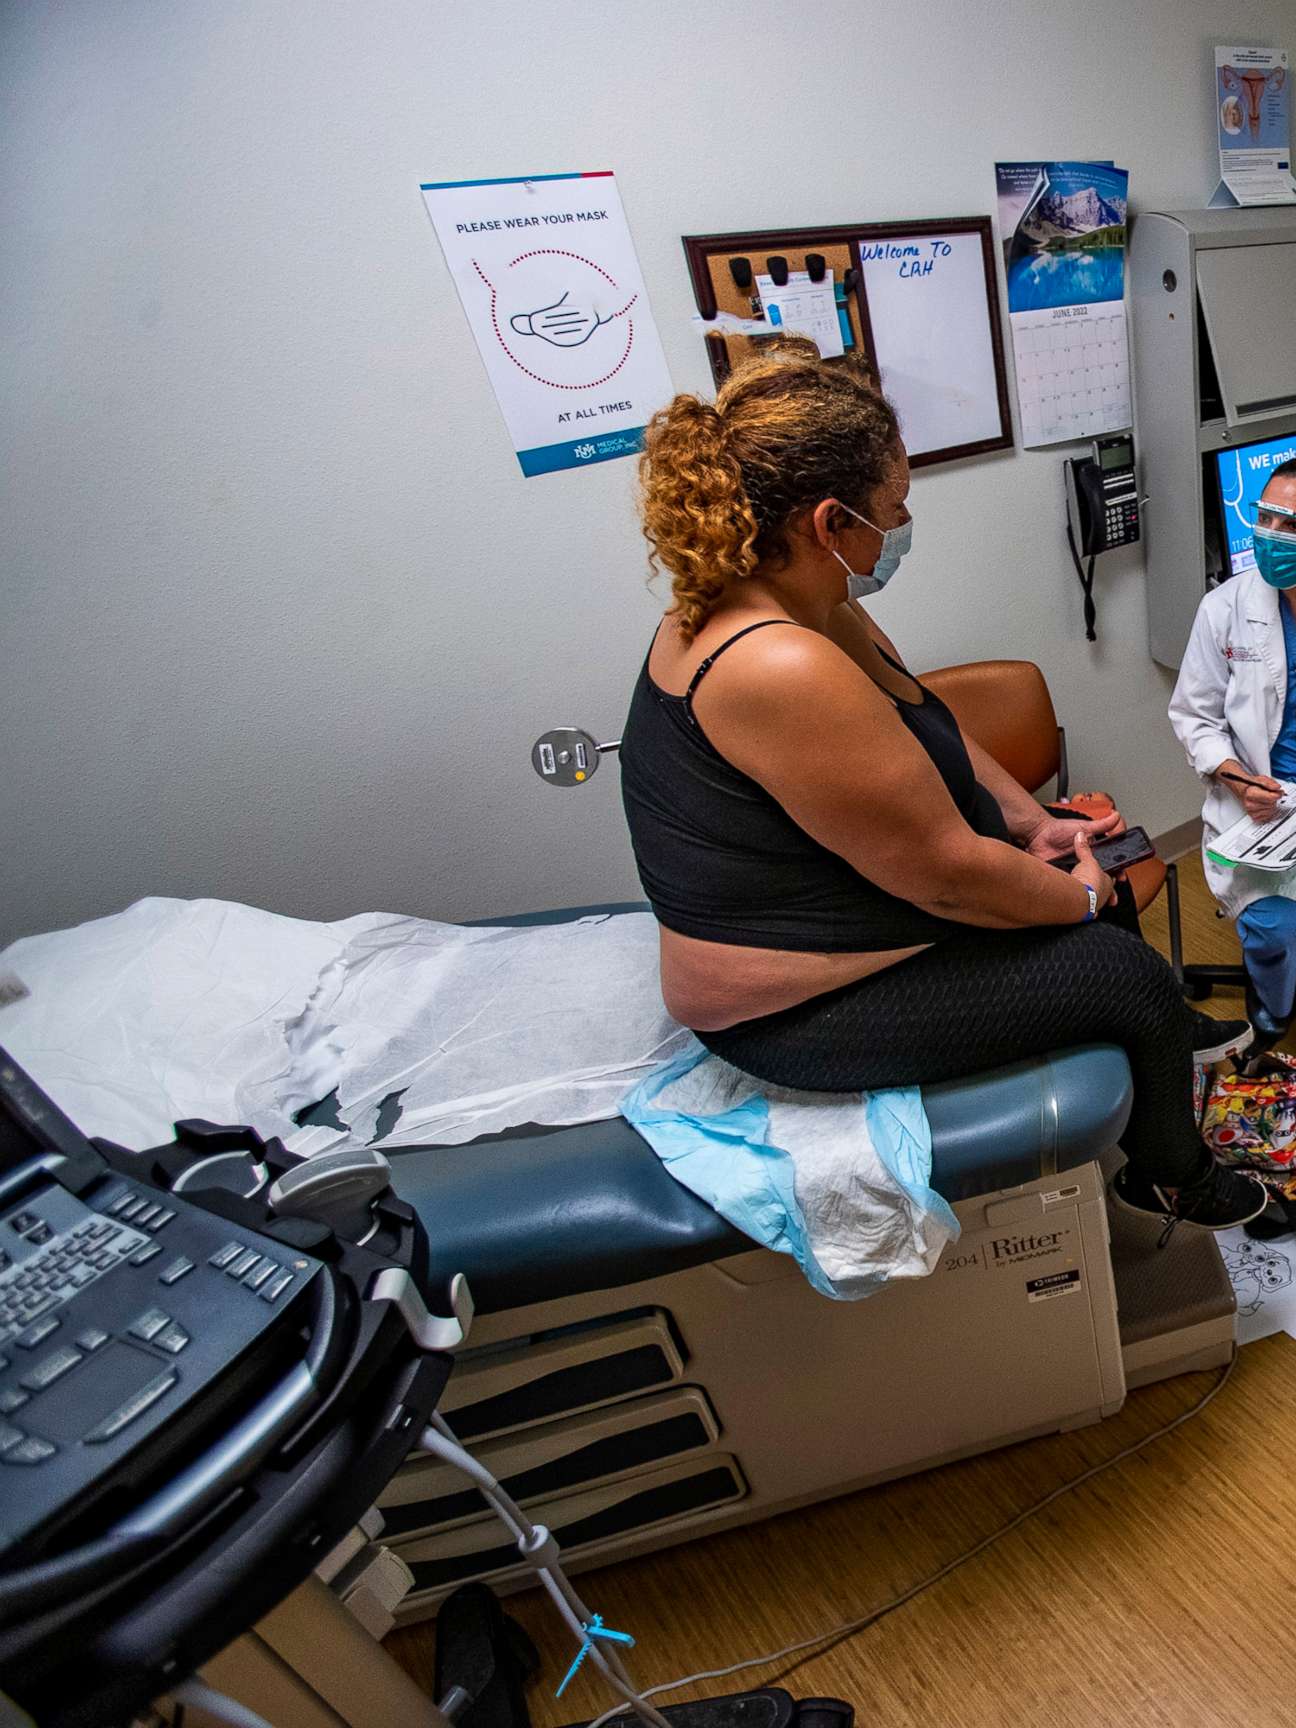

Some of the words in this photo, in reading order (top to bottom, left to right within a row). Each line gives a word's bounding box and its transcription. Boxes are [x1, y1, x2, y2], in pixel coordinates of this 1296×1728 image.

[456, 220, 501, 234] PLEASE
[504, 217, 540, 229] WEAR
[542, 213, 574, 225] YOUR
[576, 210, 609, 222] MASK
[862, 244, 920, 260] Welcome
[1052, 308, 1072, 319] JUNE
[1072, 306, 1088, 316] 2022
[558, 412, 571, 424] AT
[575, 408, 598, 420] ALL
[598, 400, 633, 414] TIMES
[596, 438, 626, 448] MEDICAL
[1248, 453, 1271, 470] WE
[945, 1254, 978, 1272] 204
[991, 1231, 1063, 1259] Ritter
[1009, 1246, 1063, 1264] MIDMARK
